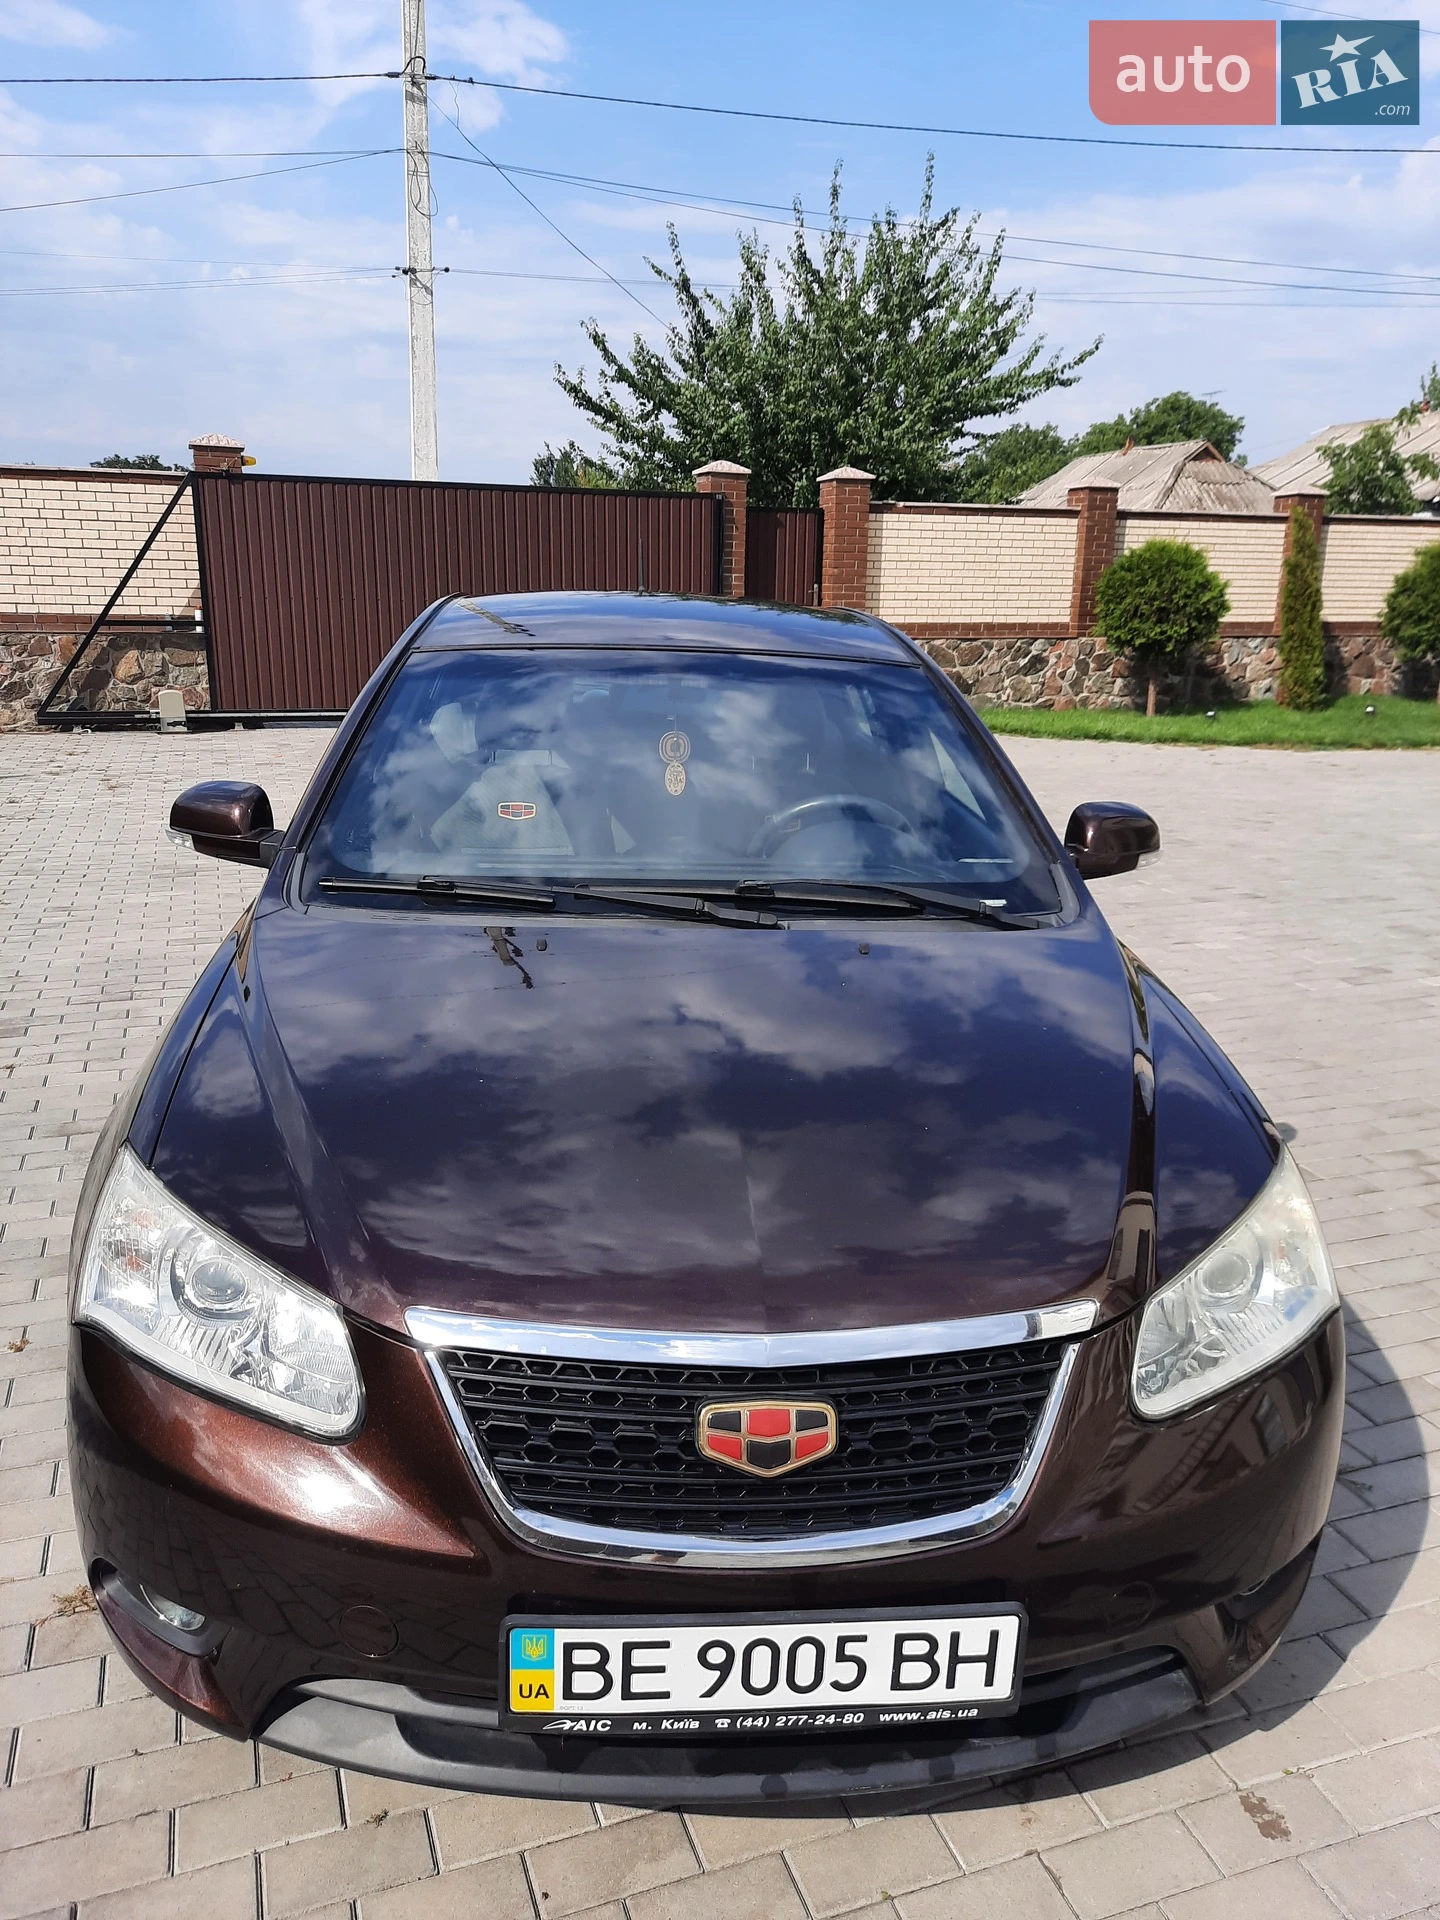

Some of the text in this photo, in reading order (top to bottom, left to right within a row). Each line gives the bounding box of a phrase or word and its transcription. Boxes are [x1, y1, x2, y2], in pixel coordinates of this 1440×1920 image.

[562, 1629, 1000, 1701] BE 9005 BH
[519, 1683, 550, 1699] UA
[660, 1718, 700, 1730] Київ
[736, 1715, 770, 1729] (44)
[775, 1712, 865, 1728] 277-24-80
[879, 1707, 979, 1723] www.ais.ua
